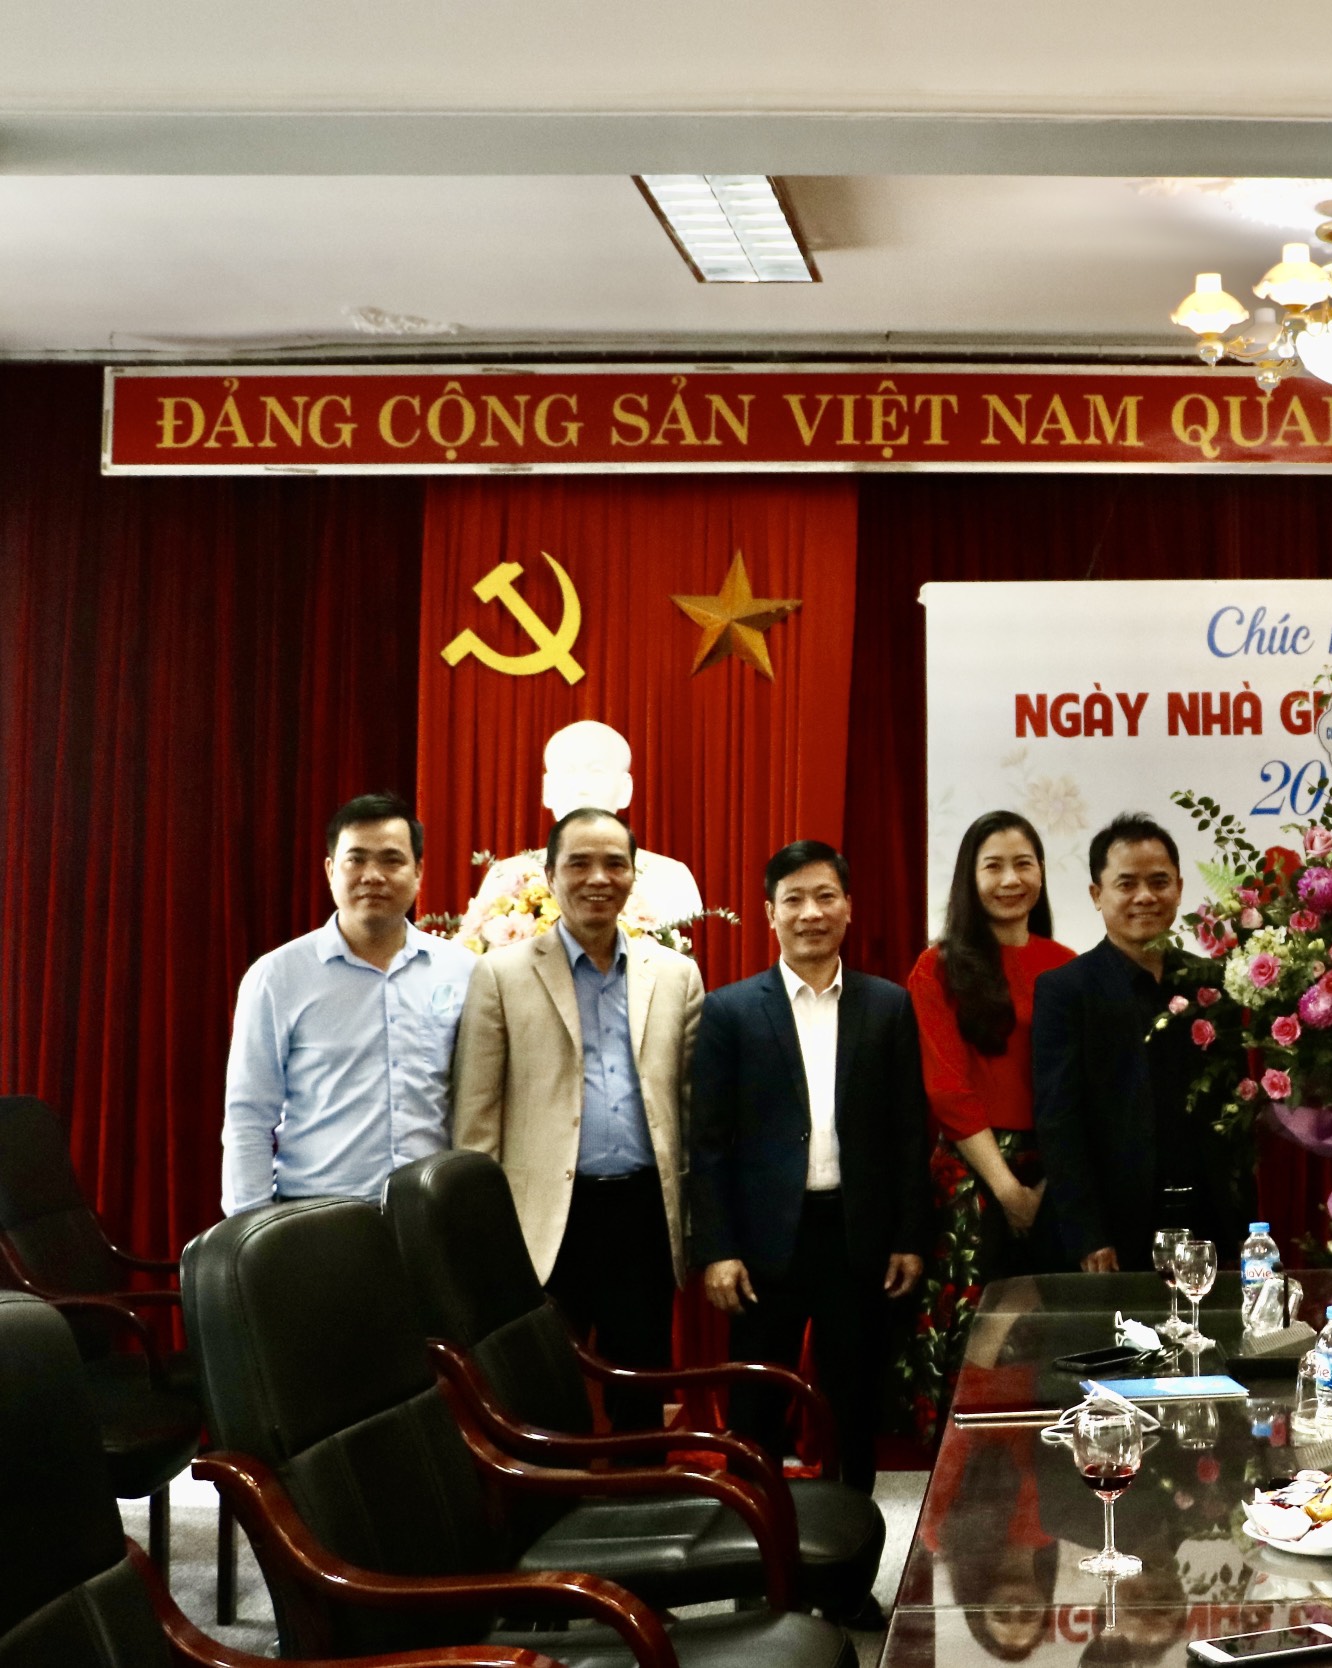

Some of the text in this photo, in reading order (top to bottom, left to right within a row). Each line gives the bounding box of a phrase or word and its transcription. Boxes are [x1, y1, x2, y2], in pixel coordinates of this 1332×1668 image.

[155, 377, 358, 449] ĐẢNG
[378, 380, 584, 461] CỘNG
[611, 375, 756, 447] SẢN
[783, 379, 960, 459] VIỆT
[980, 394, 1146, 447] NAM
[1207, 605, 1315, 658] Chúc
[1014, 682, 1150, 738] NGÀY
[1167, 680, 1263, 737] NHÀ
